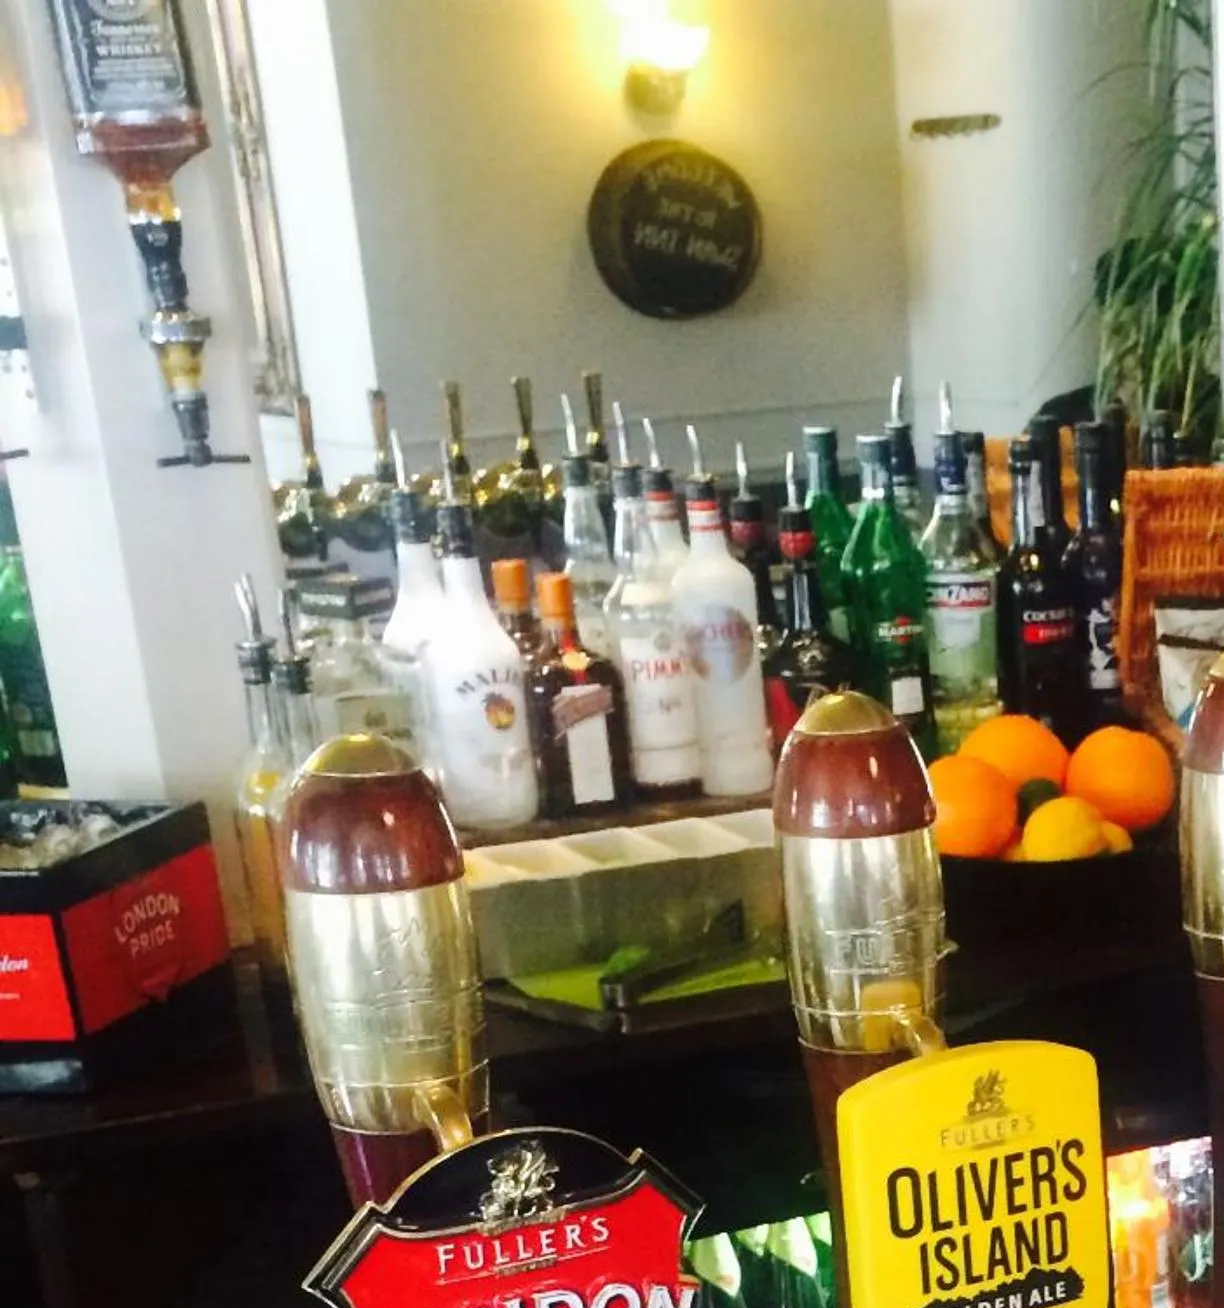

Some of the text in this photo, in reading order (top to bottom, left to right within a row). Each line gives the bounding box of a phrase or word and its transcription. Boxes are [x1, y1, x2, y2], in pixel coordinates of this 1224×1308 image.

[114, 892, 181, 943] LONDON
[129, 920, 176, 960] PRIDE
[886, 1138, 1087, 1239] OLIVER'S
[436, 1216, 611, 1276] FULLER'S
[919, 1211, 1070, 1295] ISLAND
[1028, 1282, 1067, 1306] ALE
